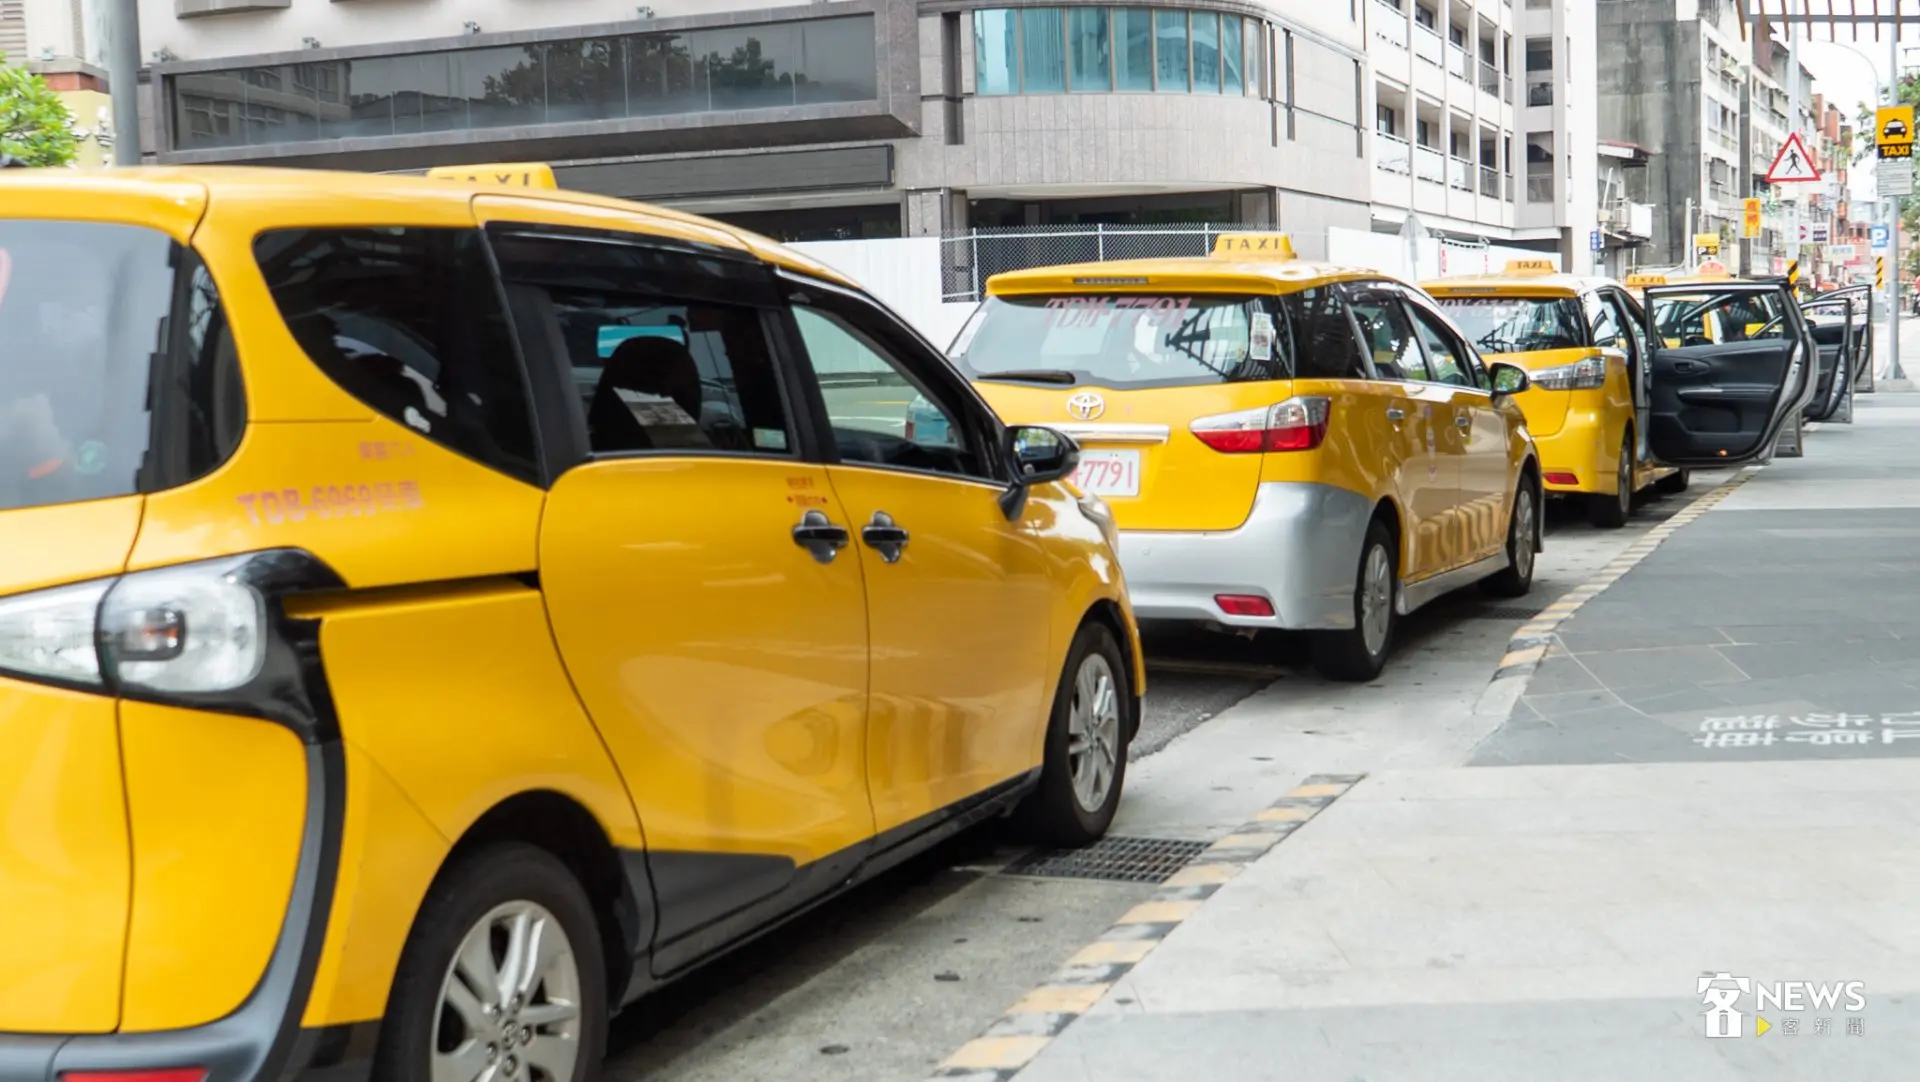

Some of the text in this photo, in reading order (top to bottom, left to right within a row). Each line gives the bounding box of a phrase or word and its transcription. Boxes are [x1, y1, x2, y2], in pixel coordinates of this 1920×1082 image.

[1881, 145, 1910, 157] TAXI
[437, 172, 529, 186] XI
[1224, 237, 1279, 250] TAXI
[1872, 228, 1887, 246] P
[1517, 260, 1543, 269] TAXI
[1043, 296, 1191, 329] TDM-7791
